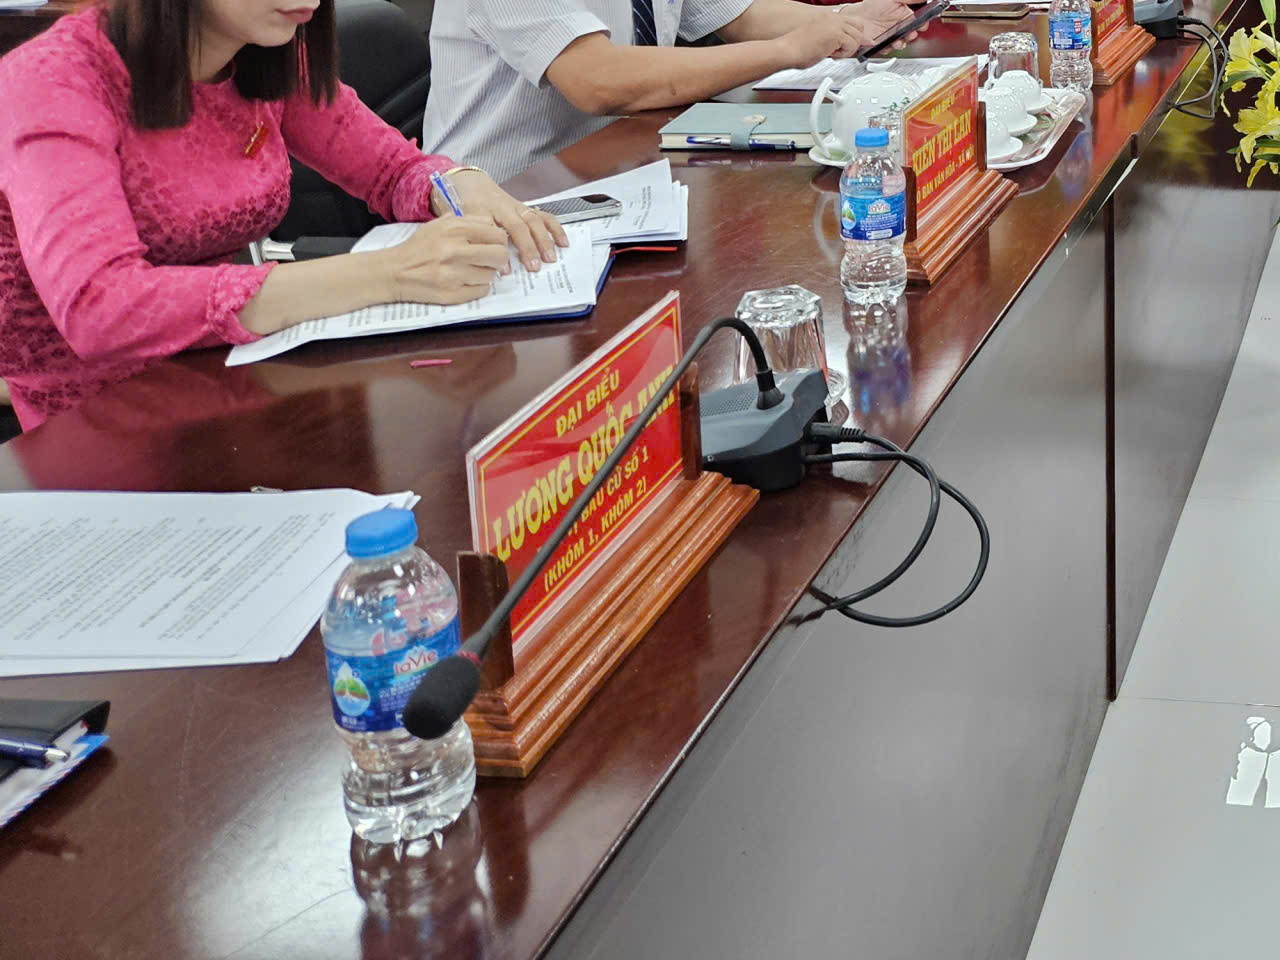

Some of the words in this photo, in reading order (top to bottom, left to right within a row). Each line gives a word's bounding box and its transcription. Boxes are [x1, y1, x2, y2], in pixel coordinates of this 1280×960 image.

[556, 401, 582, 438] ĐẠI
[586, 367, 620, 411] BIỂU
[624, 449, 640, 479] SỐ
[642, 446, 649, 464] 1
[493, 455, 575, 562] LƯƠNG
[544, 538, 585, 592] (KHÓM
[588, 528, 599, 546] 1,
[601, 490, 634, 532] KHÓM
[636, 476, 647, 498] 2)
